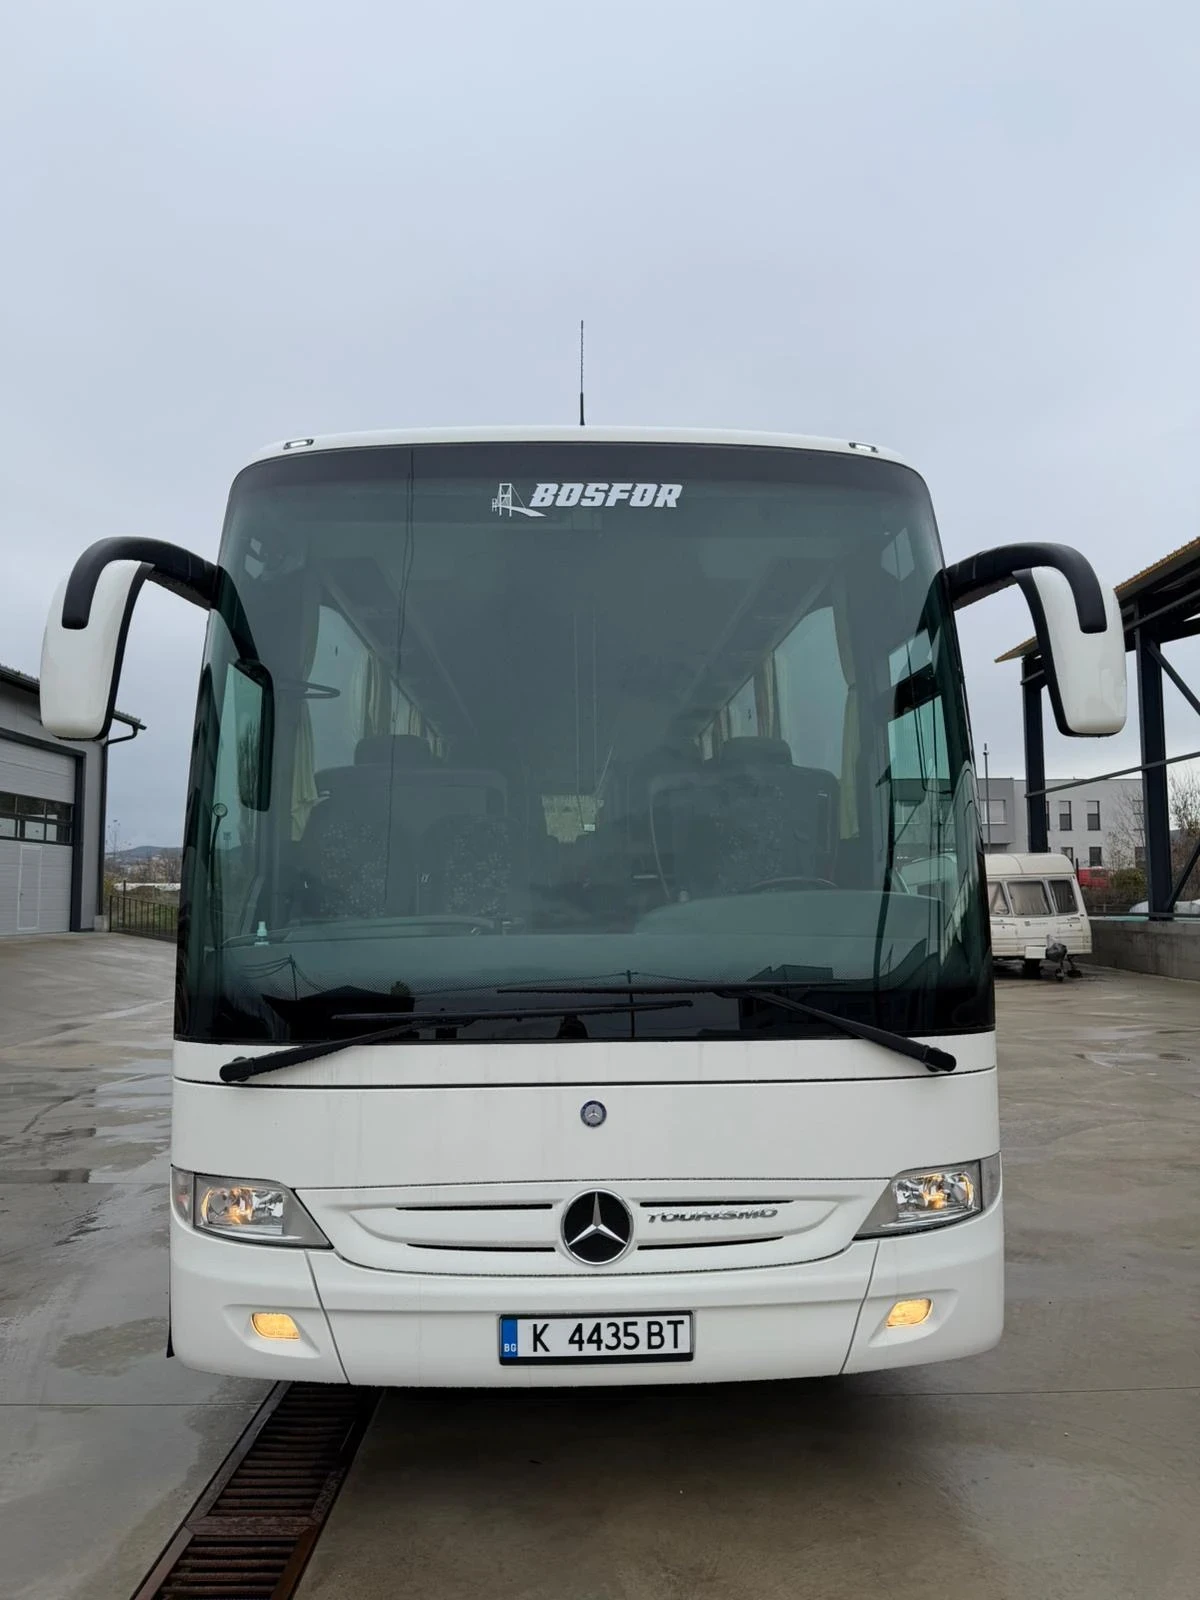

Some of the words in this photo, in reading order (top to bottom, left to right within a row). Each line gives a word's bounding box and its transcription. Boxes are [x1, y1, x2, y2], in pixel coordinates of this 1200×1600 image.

[529, 483, 683, 507] BOSFOR
[648, 1209, 778, 1223] TOURISMO
[504, 1343, 516, 1352] BG
